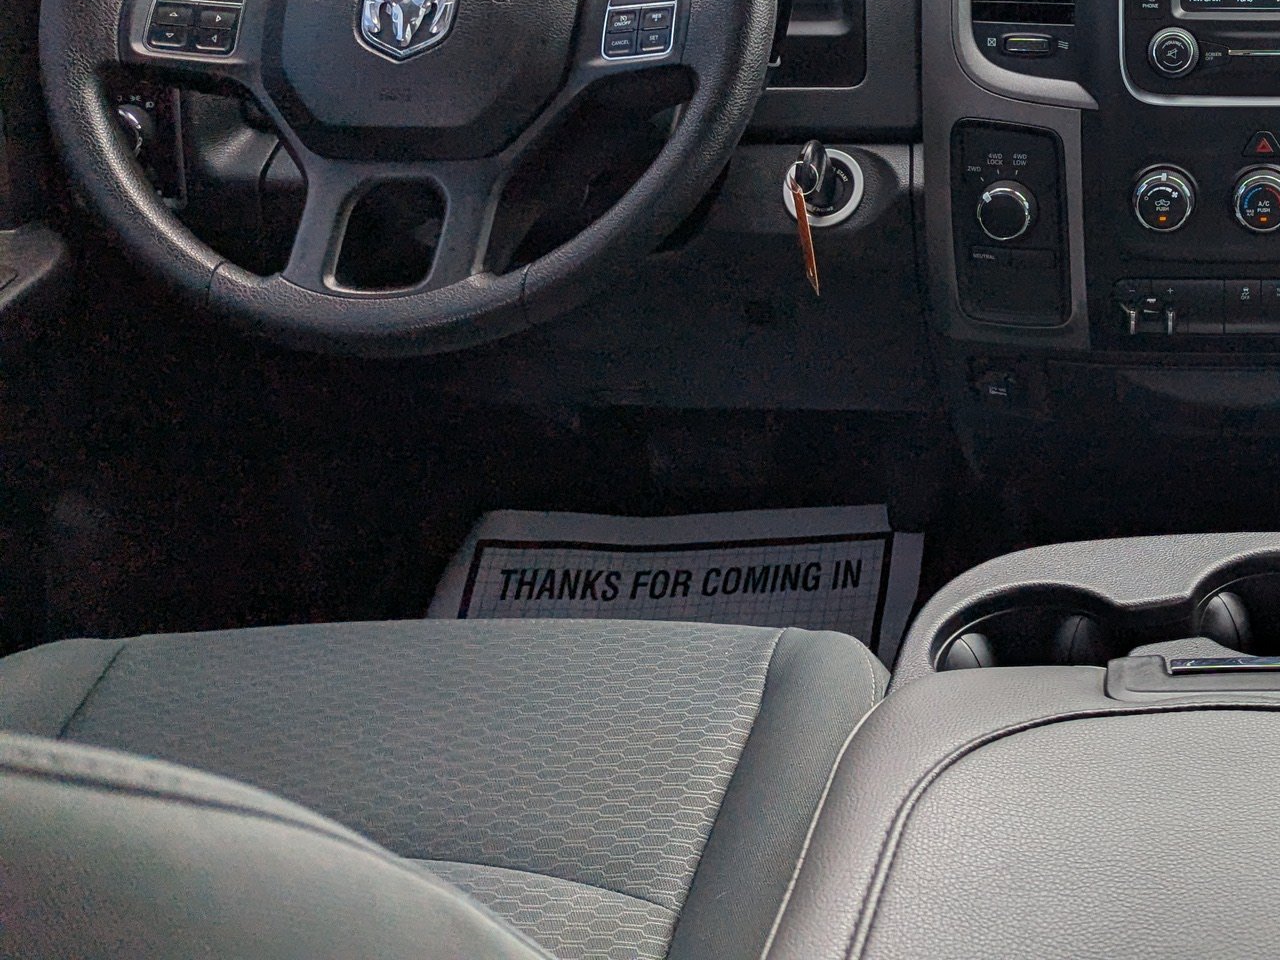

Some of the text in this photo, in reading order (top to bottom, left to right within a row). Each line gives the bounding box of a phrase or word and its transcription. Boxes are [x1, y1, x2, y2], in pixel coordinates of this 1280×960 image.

[836, 169, 849, 182] START
[500, 559, 863, 602] THANKS FOR COMING IN
